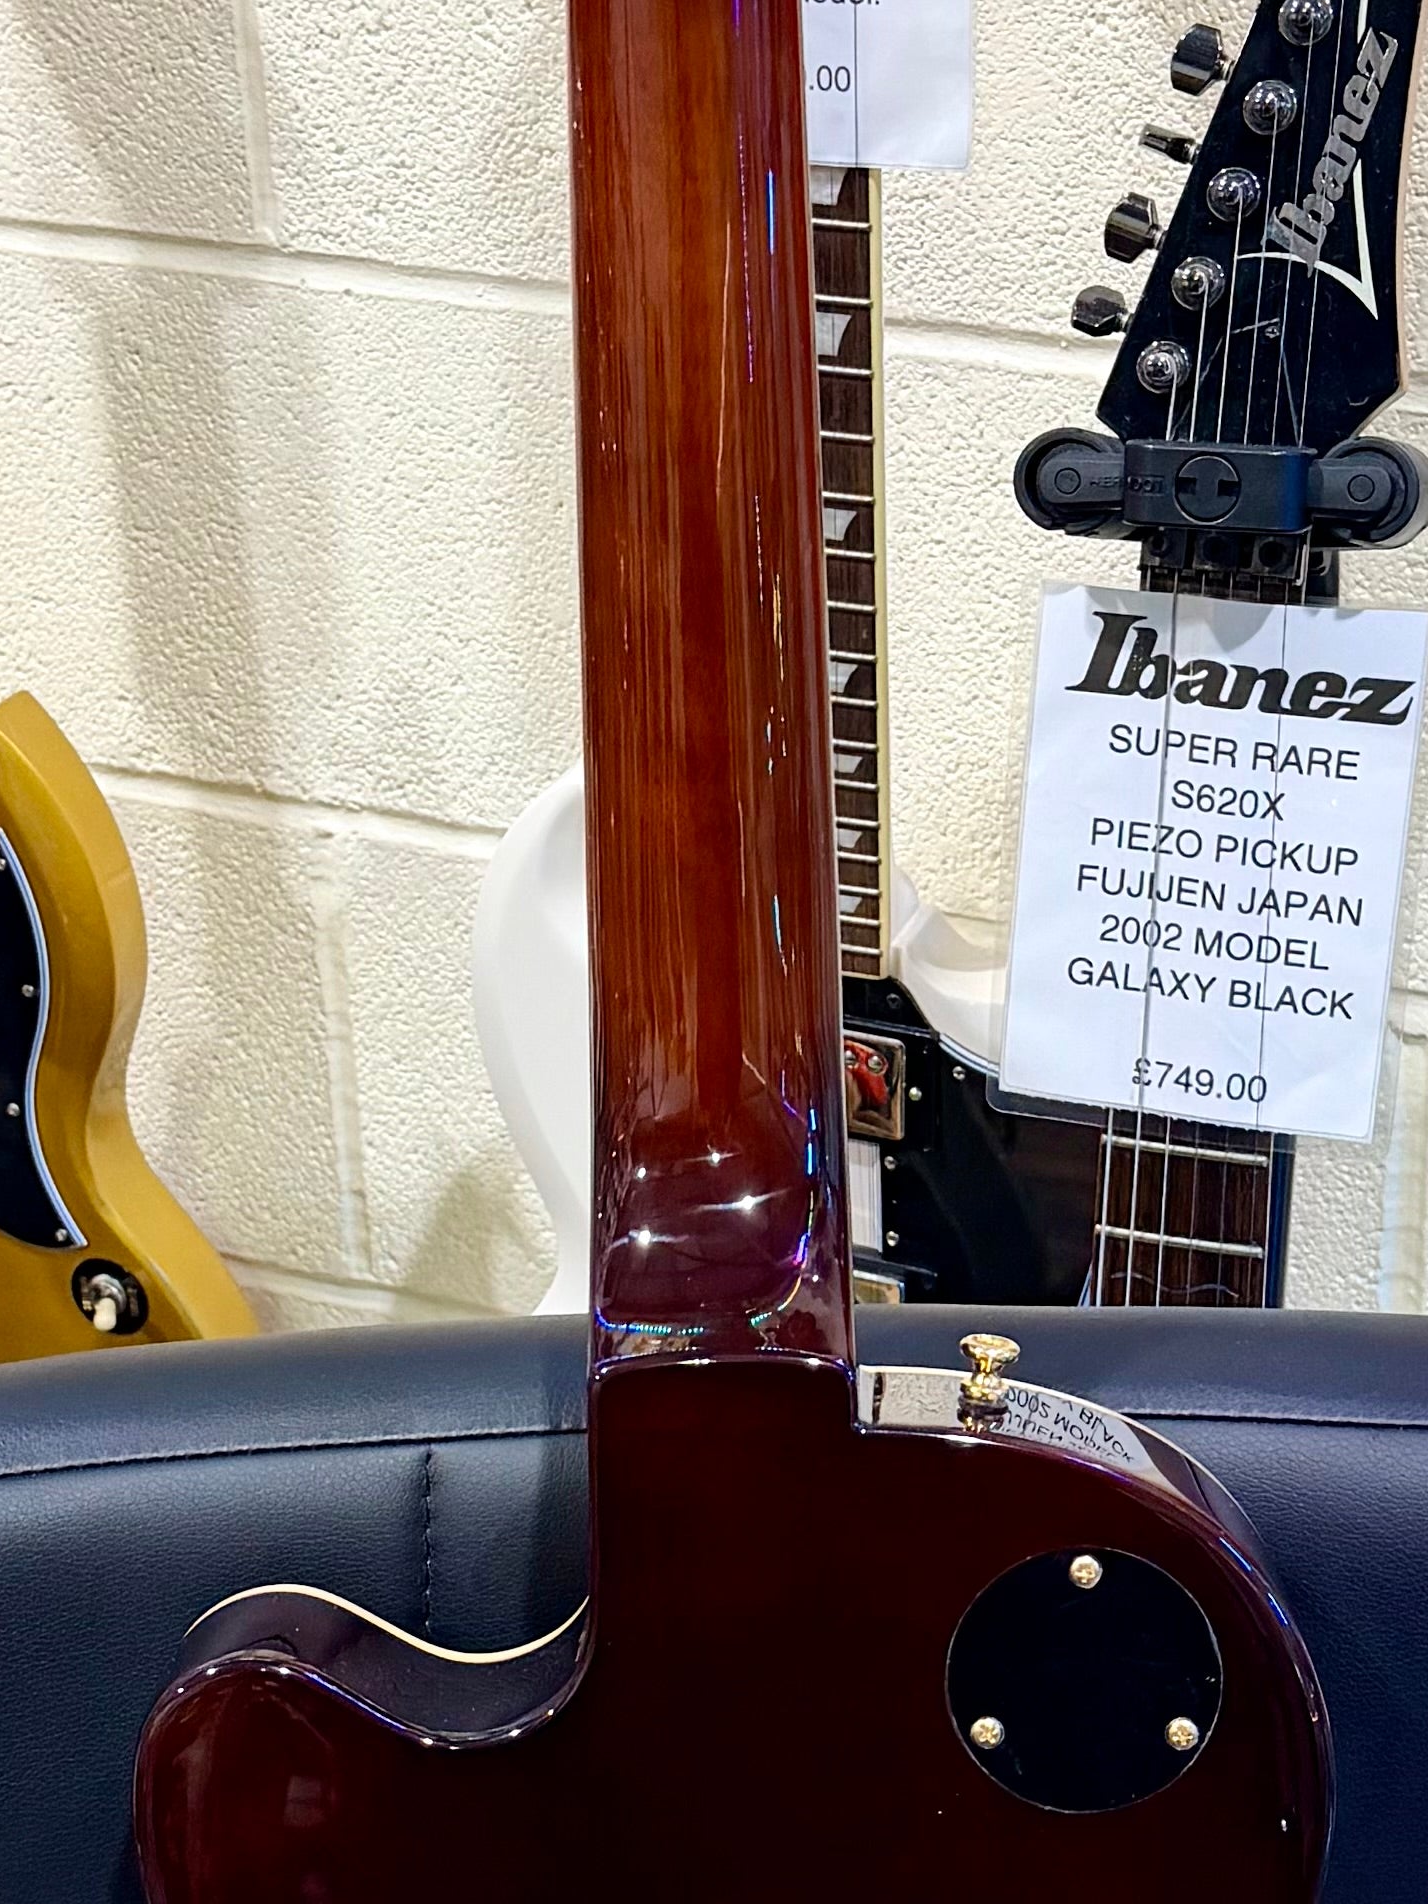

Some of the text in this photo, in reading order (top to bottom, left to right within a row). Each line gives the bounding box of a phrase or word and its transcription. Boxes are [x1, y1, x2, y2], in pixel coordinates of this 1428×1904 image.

[1261, 26, 1400, 279] Ibanez
[1063, 609, 1416, 727] Ibanez
[1108, 722, 1361, 781] SUPER RARE
[1171, 779, 1286, 822] S620X
[1090, 817, 1360, 878] PIEZO PICKUP
[1076, 864, 1364, 928] FUJIJEN JAPAN
[1098, 913, 1330, 971] 2002 MODEL
[1066, 956, 1355, 1021] GALAXY BLACK
[1131, 1056, 1268, 1104] £749.00
